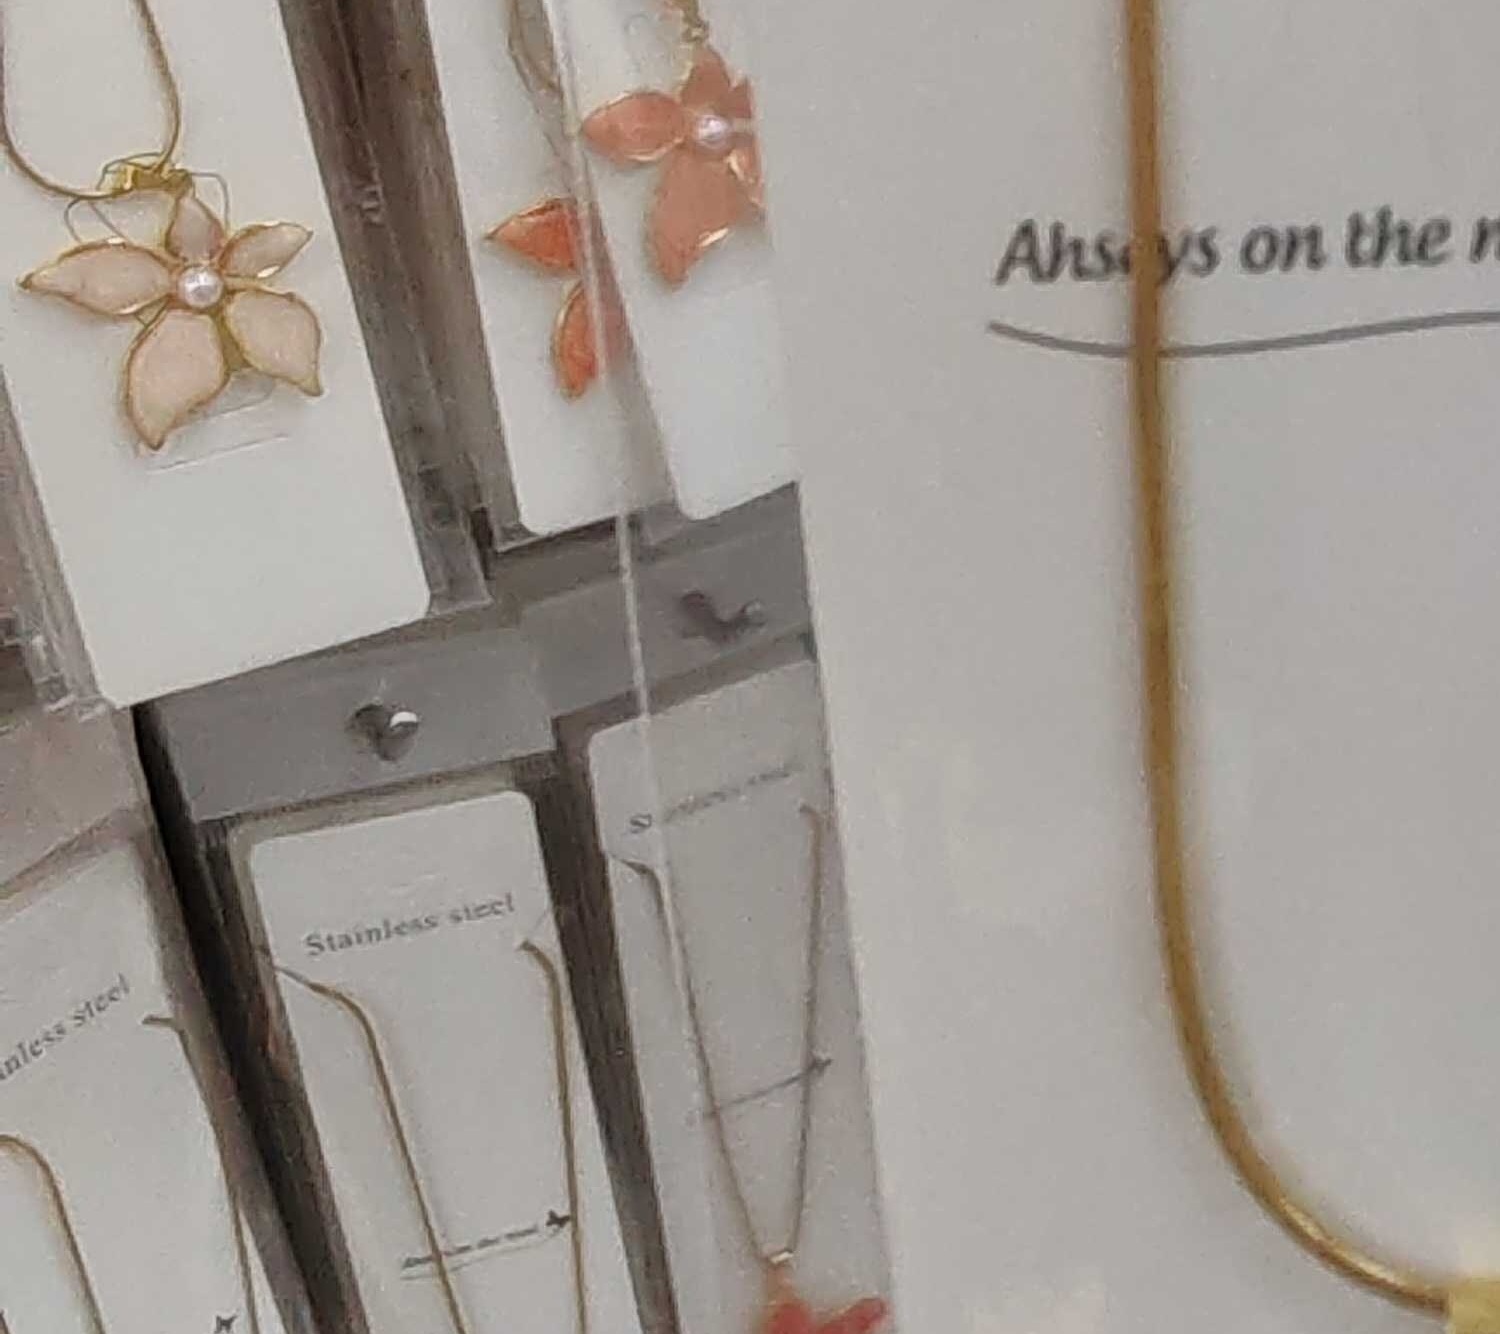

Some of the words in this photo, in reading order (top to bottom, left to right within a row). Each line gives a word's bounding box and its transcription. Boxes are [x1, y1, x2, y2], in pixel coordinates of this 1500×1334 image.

[1240, 224, 1327, 275] on
[1344, 203, 1454, 269] the
[304, 917, 439, 958] Stainless
[448, 891, 516, 925] steel
